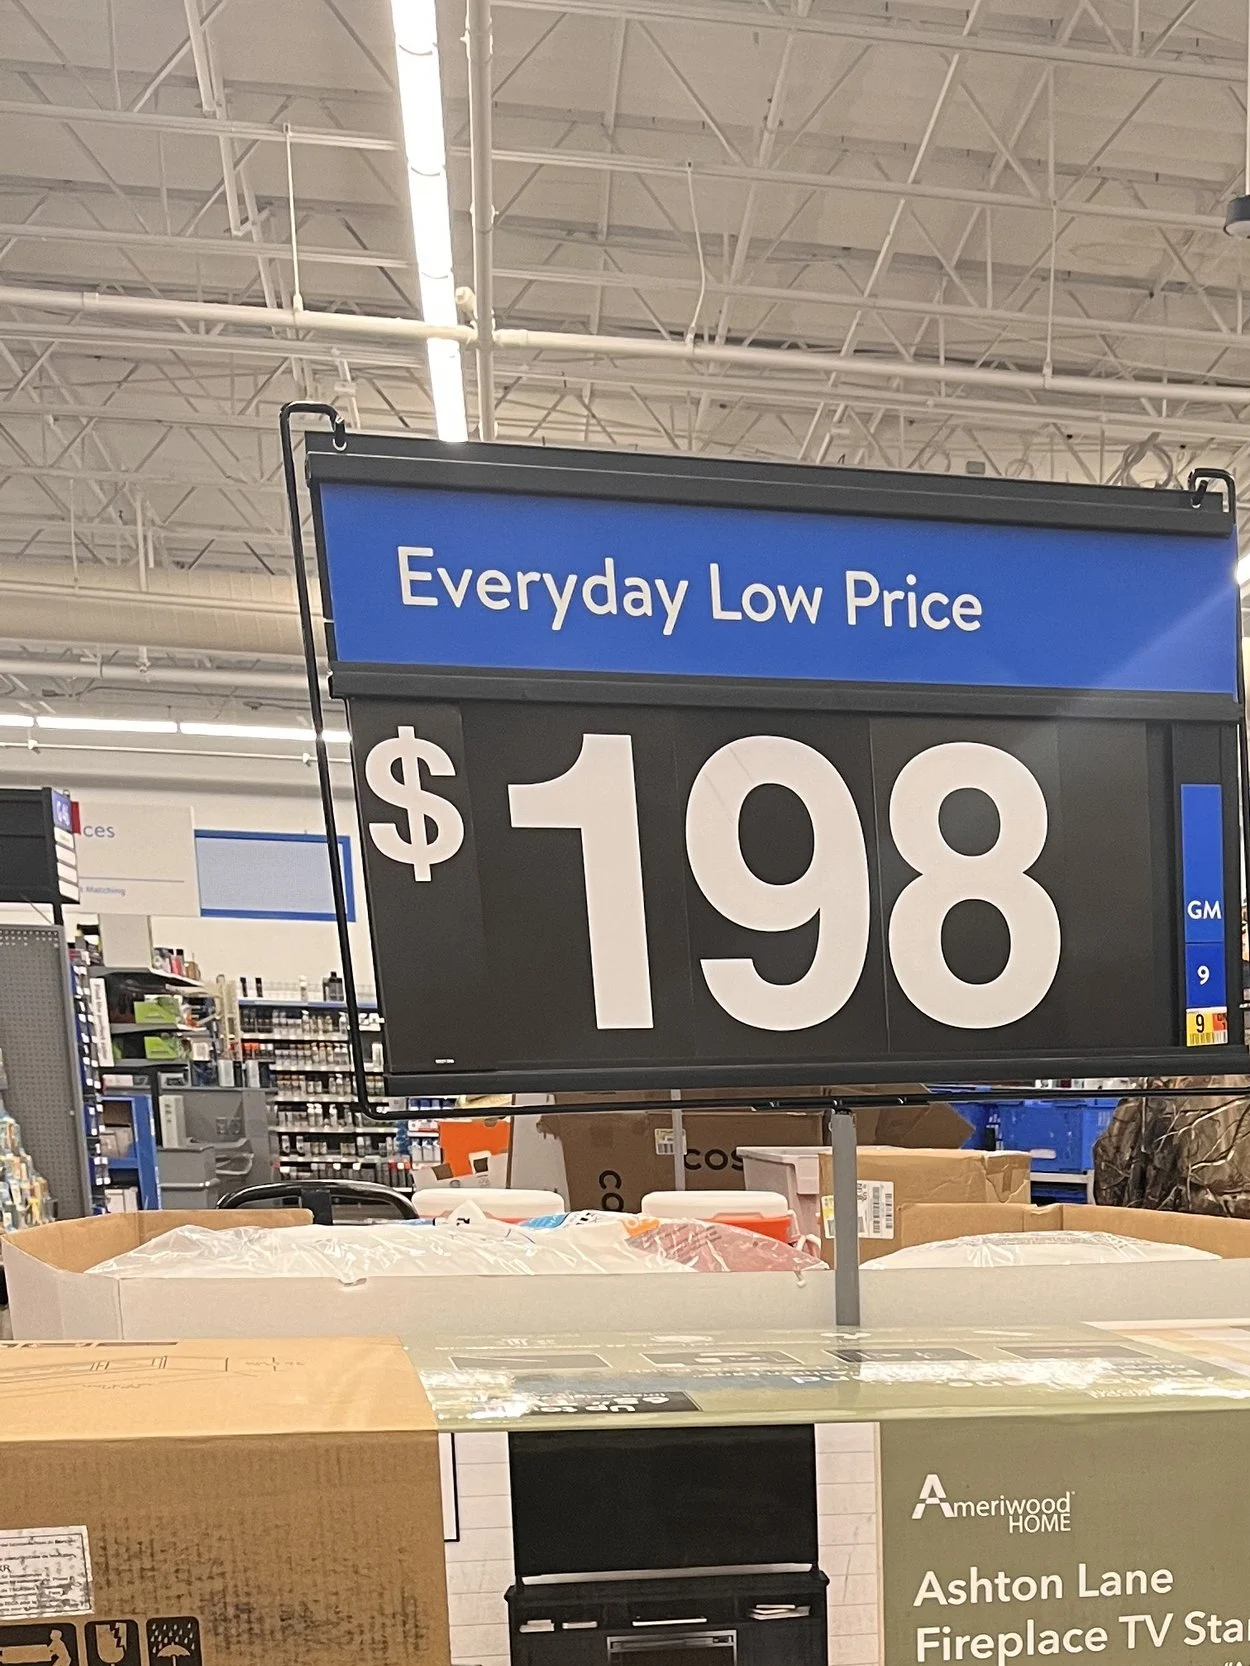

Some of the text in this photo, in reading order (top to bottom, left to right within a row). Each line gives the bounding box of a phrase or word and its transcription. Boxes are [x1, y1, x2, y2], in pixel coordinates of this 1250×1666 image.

[398, 546, 982, 635] Everyday Low Price
[1188, 901, 1221, 919] GM
[1198, 966, 1209, 984] 9
[912, 1474, 1071, 1519] Ameriwood
[1008, 1515, 1071, 1533] HOME
[913, 1564, 1173, 1606] Ashton Lane
[1119, 1613, 1173, 1648] TV
